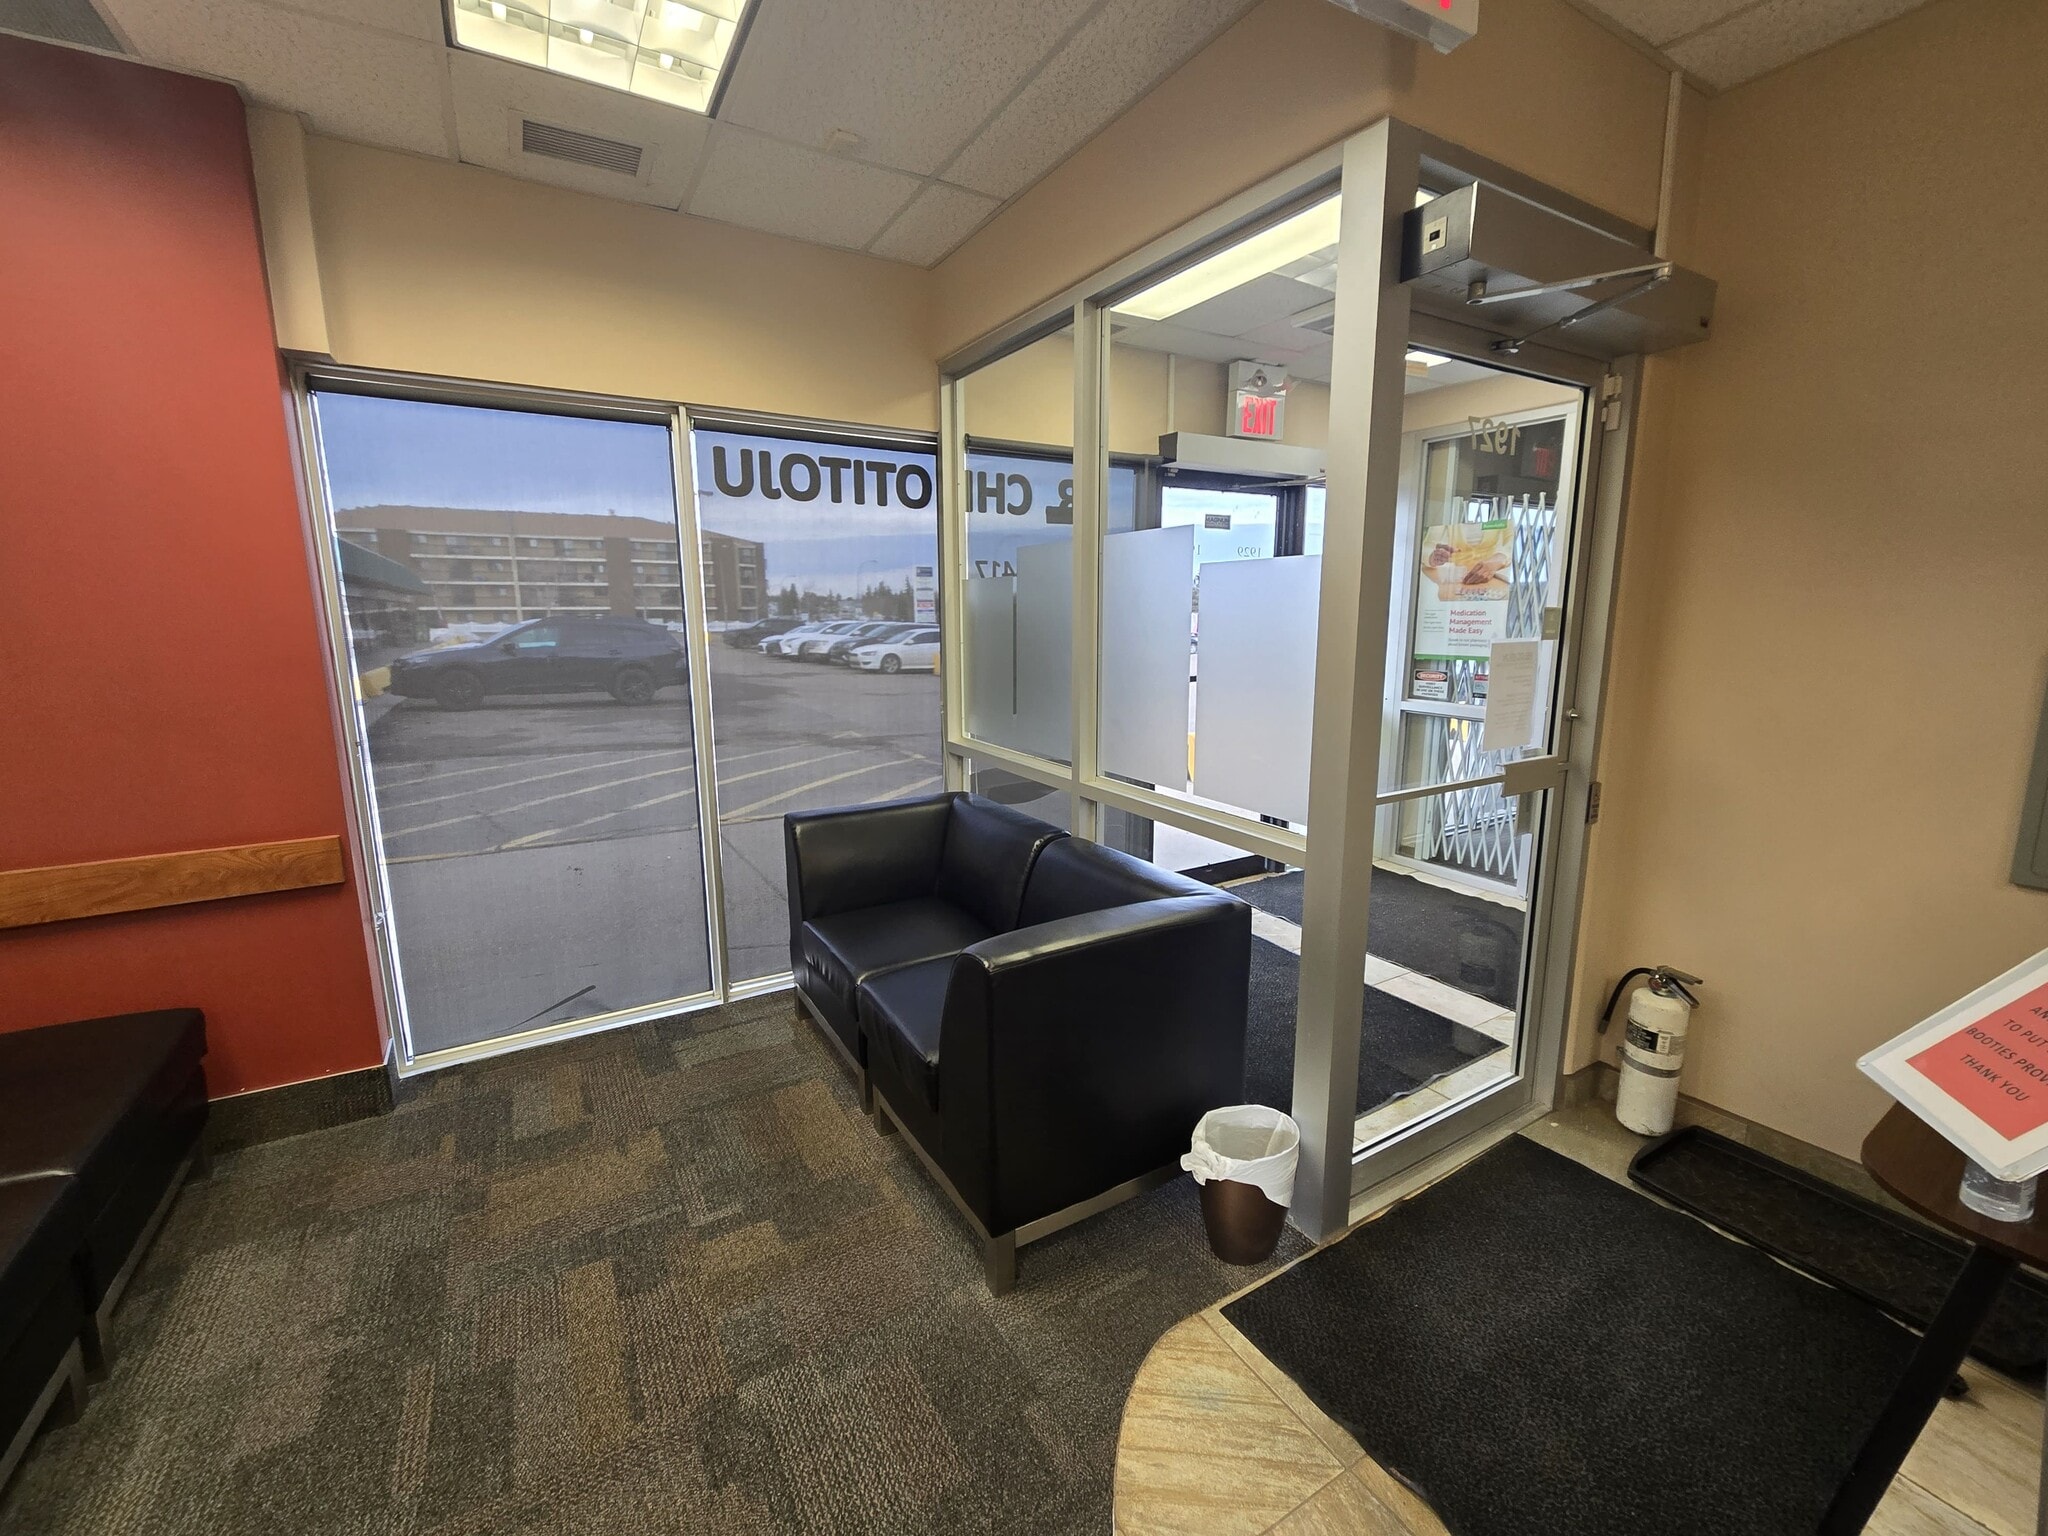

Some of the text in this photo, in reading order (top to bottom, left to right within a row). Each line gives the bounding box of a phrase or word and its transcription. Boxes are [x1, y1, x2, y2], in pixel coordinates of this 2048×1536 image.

[1242, 396, 1276, 436] EXIT
[1449, 618, 1492, 627] Management
[1450, 609, 1486, 617] Medication
[1468, 627, 1484, 636] Easy
[1966, 1027, 2018, 1060] BOOTIES
[2003, 1018, 2048, 1048] TO PUT
[1960, 1053, 2030, 1102] THANK YOU
